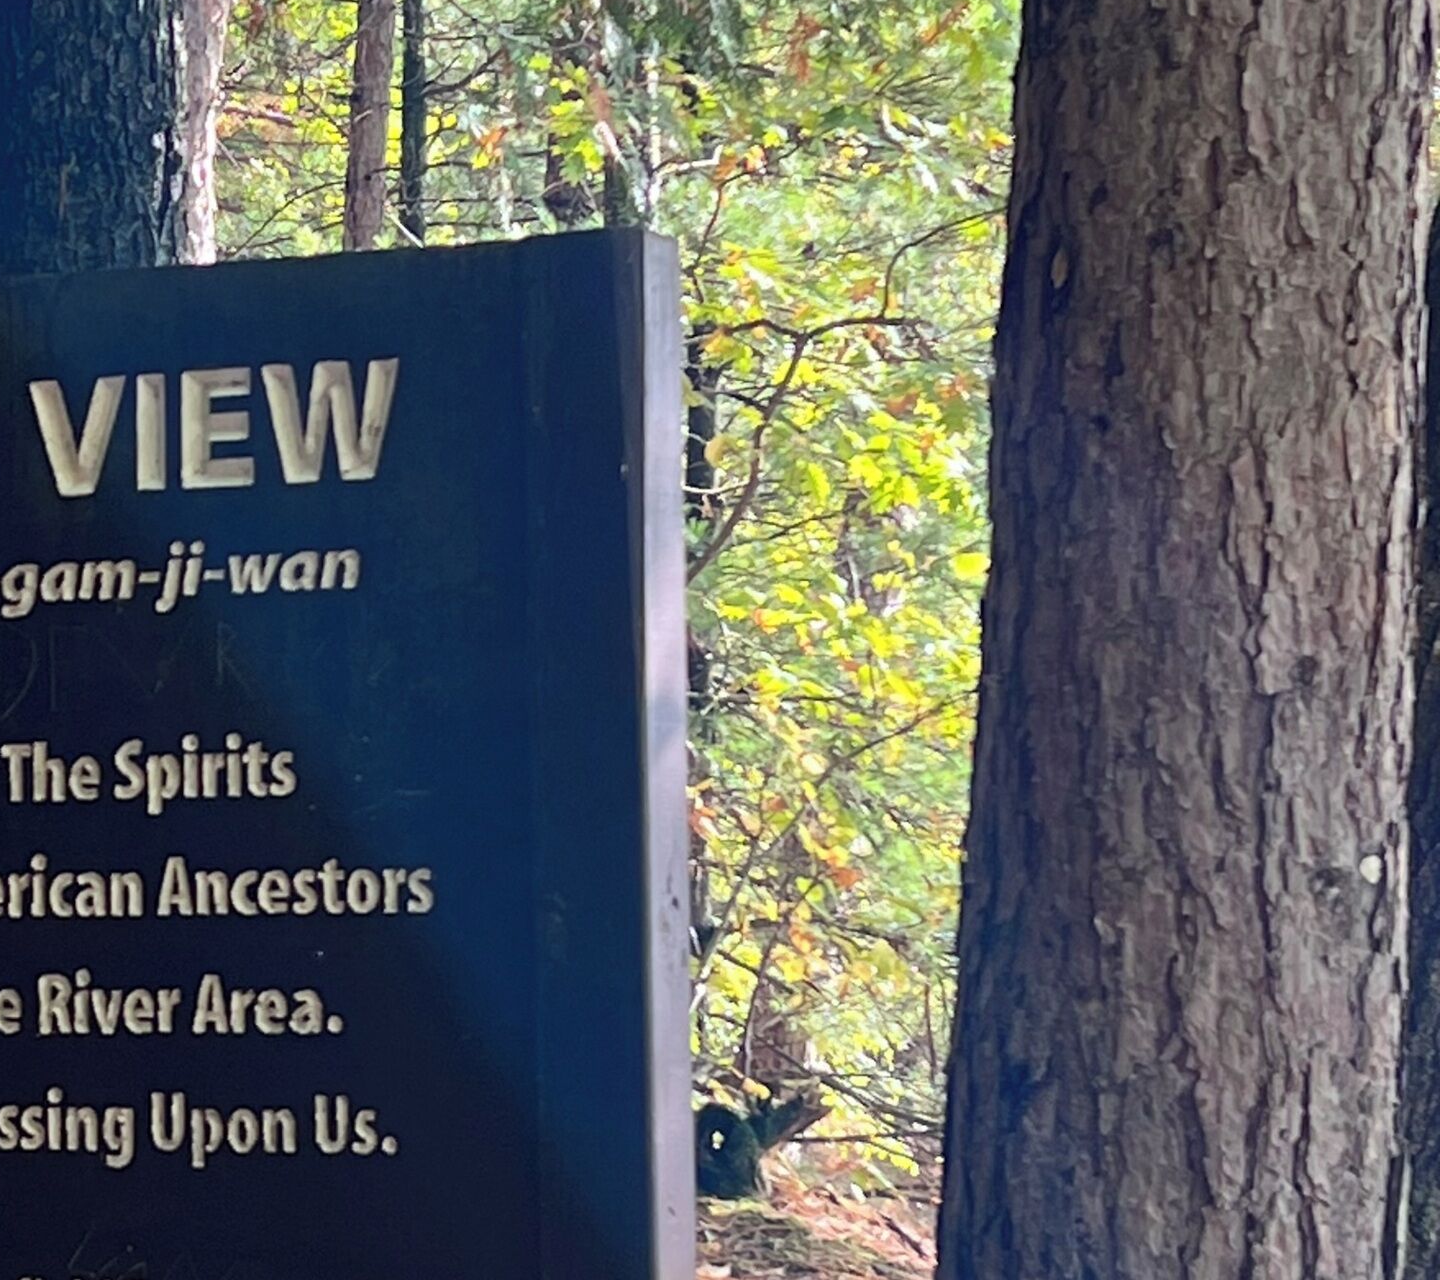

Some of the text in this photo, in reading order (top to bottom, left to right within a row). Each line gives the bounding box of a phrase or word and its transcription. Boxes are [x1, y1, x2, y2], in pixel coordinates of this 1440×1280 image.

[28, 357, 399, 498] VIEW
[0, 740, 101, 803] The
[113, 732, 297, 816] Spirits
[156, 855, 433, 917] Ancestors
[36, 968, 181, 1036] River
[191, 973, 343, 1036] Area.
[150, 1091, 297, 1169] Upon
[313, 1094, 397, 1155] Us.
